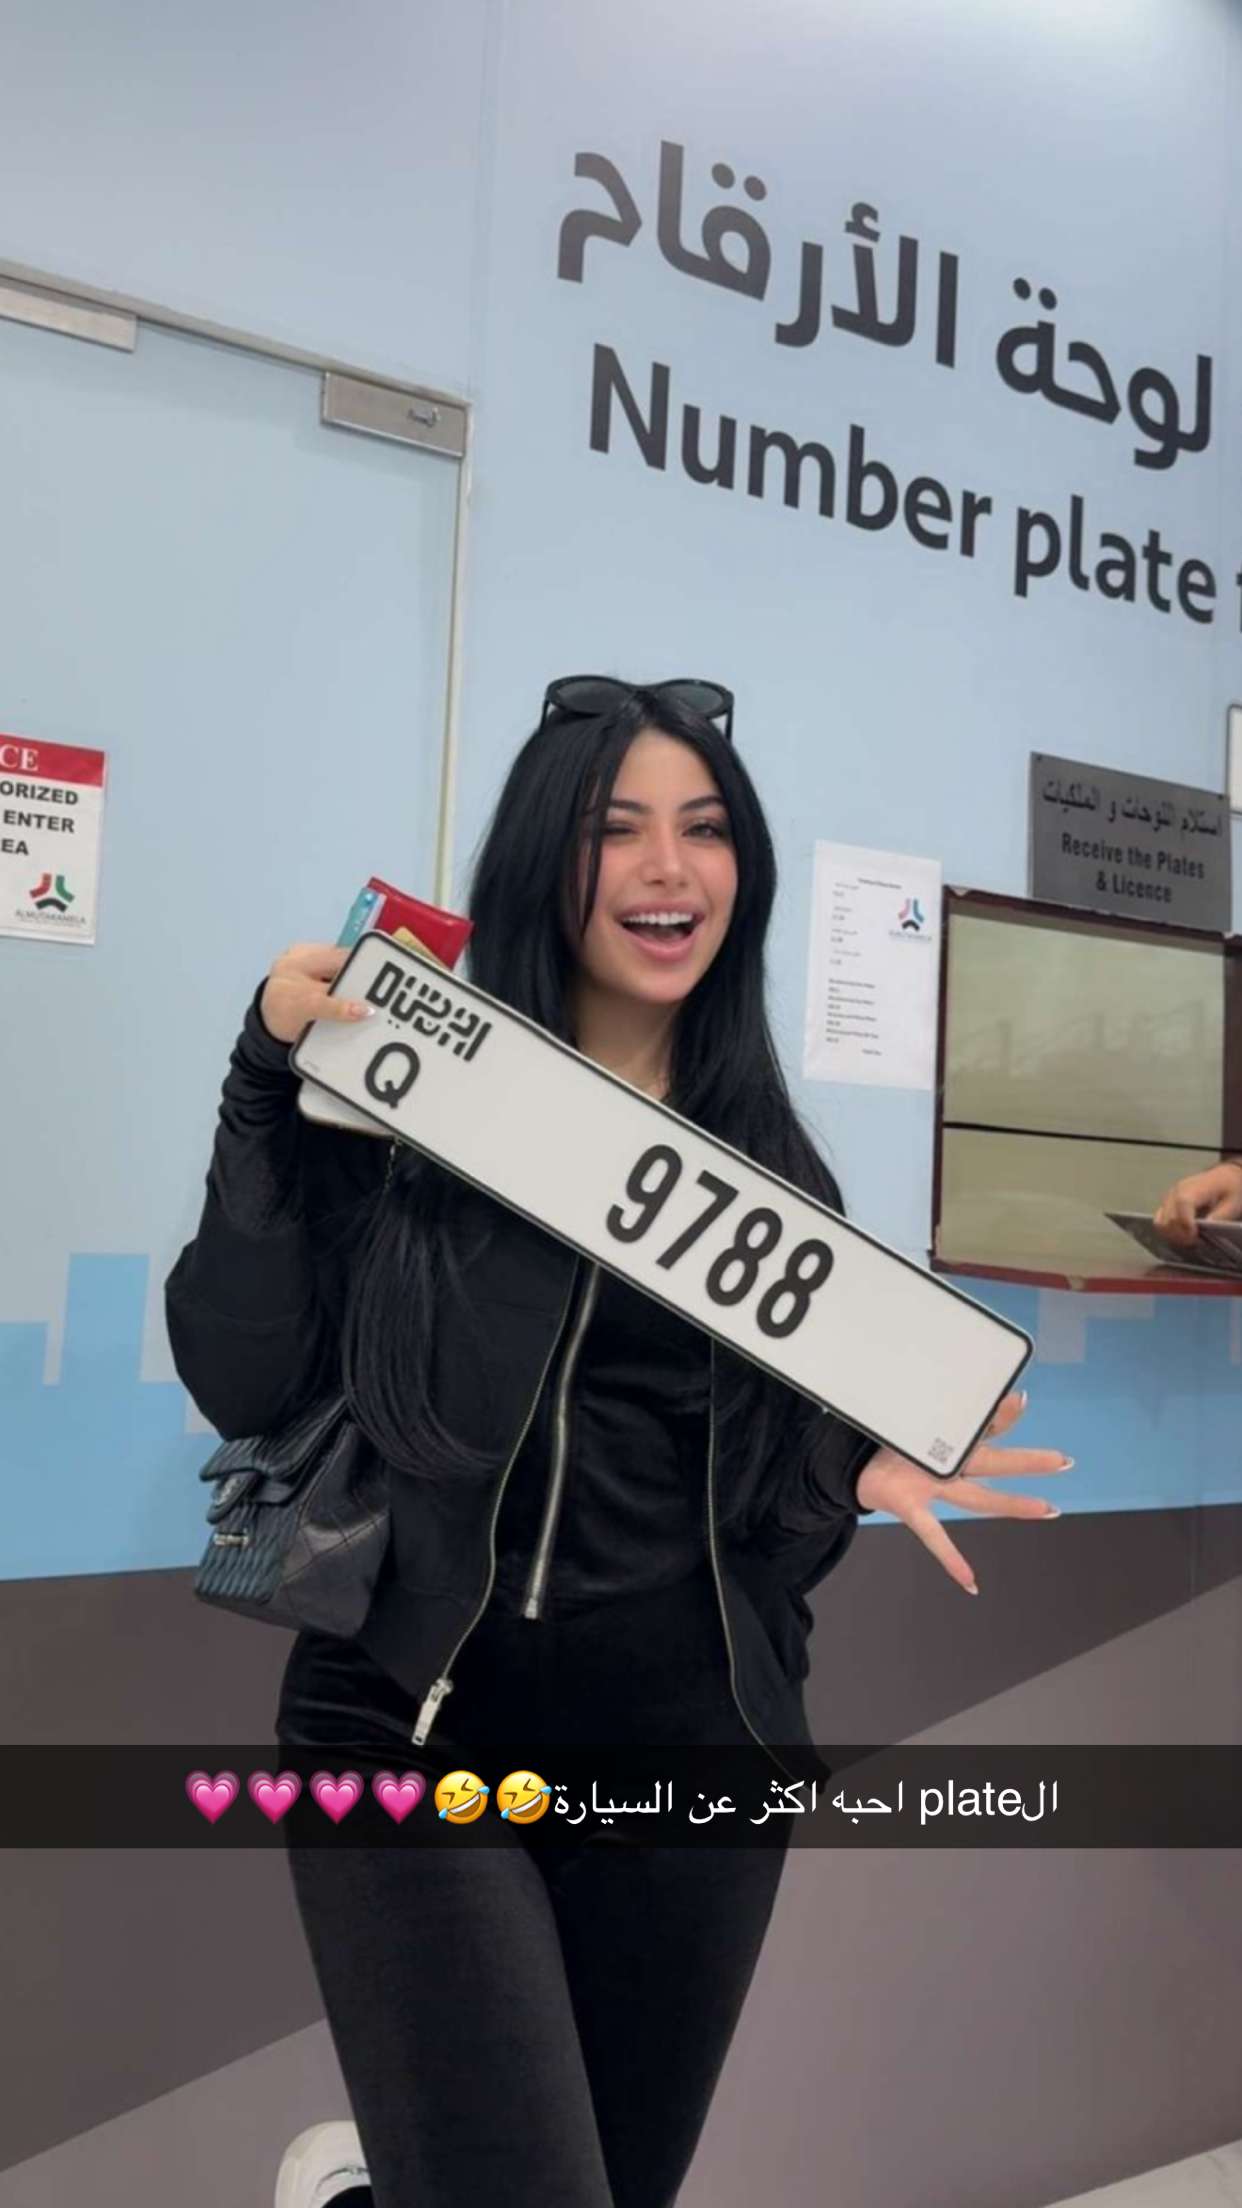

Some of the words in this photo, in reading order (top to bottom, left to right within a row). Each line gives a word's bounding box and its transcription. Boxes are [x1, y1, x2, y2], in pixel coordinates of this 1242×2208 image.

[556, 140, 959, 369] الأرقام
[995, 276, 1214, 471] لوحة
[588, 342, 993, 559] Number
[1013, 493, 1218, 625] plate
[3, 808, 75, 833] ENTER
[1107, 801, 1117, 823] و
[1061, 832, 1123, 865] Receive
[1127, 846, 1151, 870] the
[1157, 851, 1205, 879] Plates
[1095, 871, 1107, 892] &
[1112, 874, 1173, 904] Licence
[364, 1041, 421, 1109] Q
[605, 1143, 835, 1339] 9788
